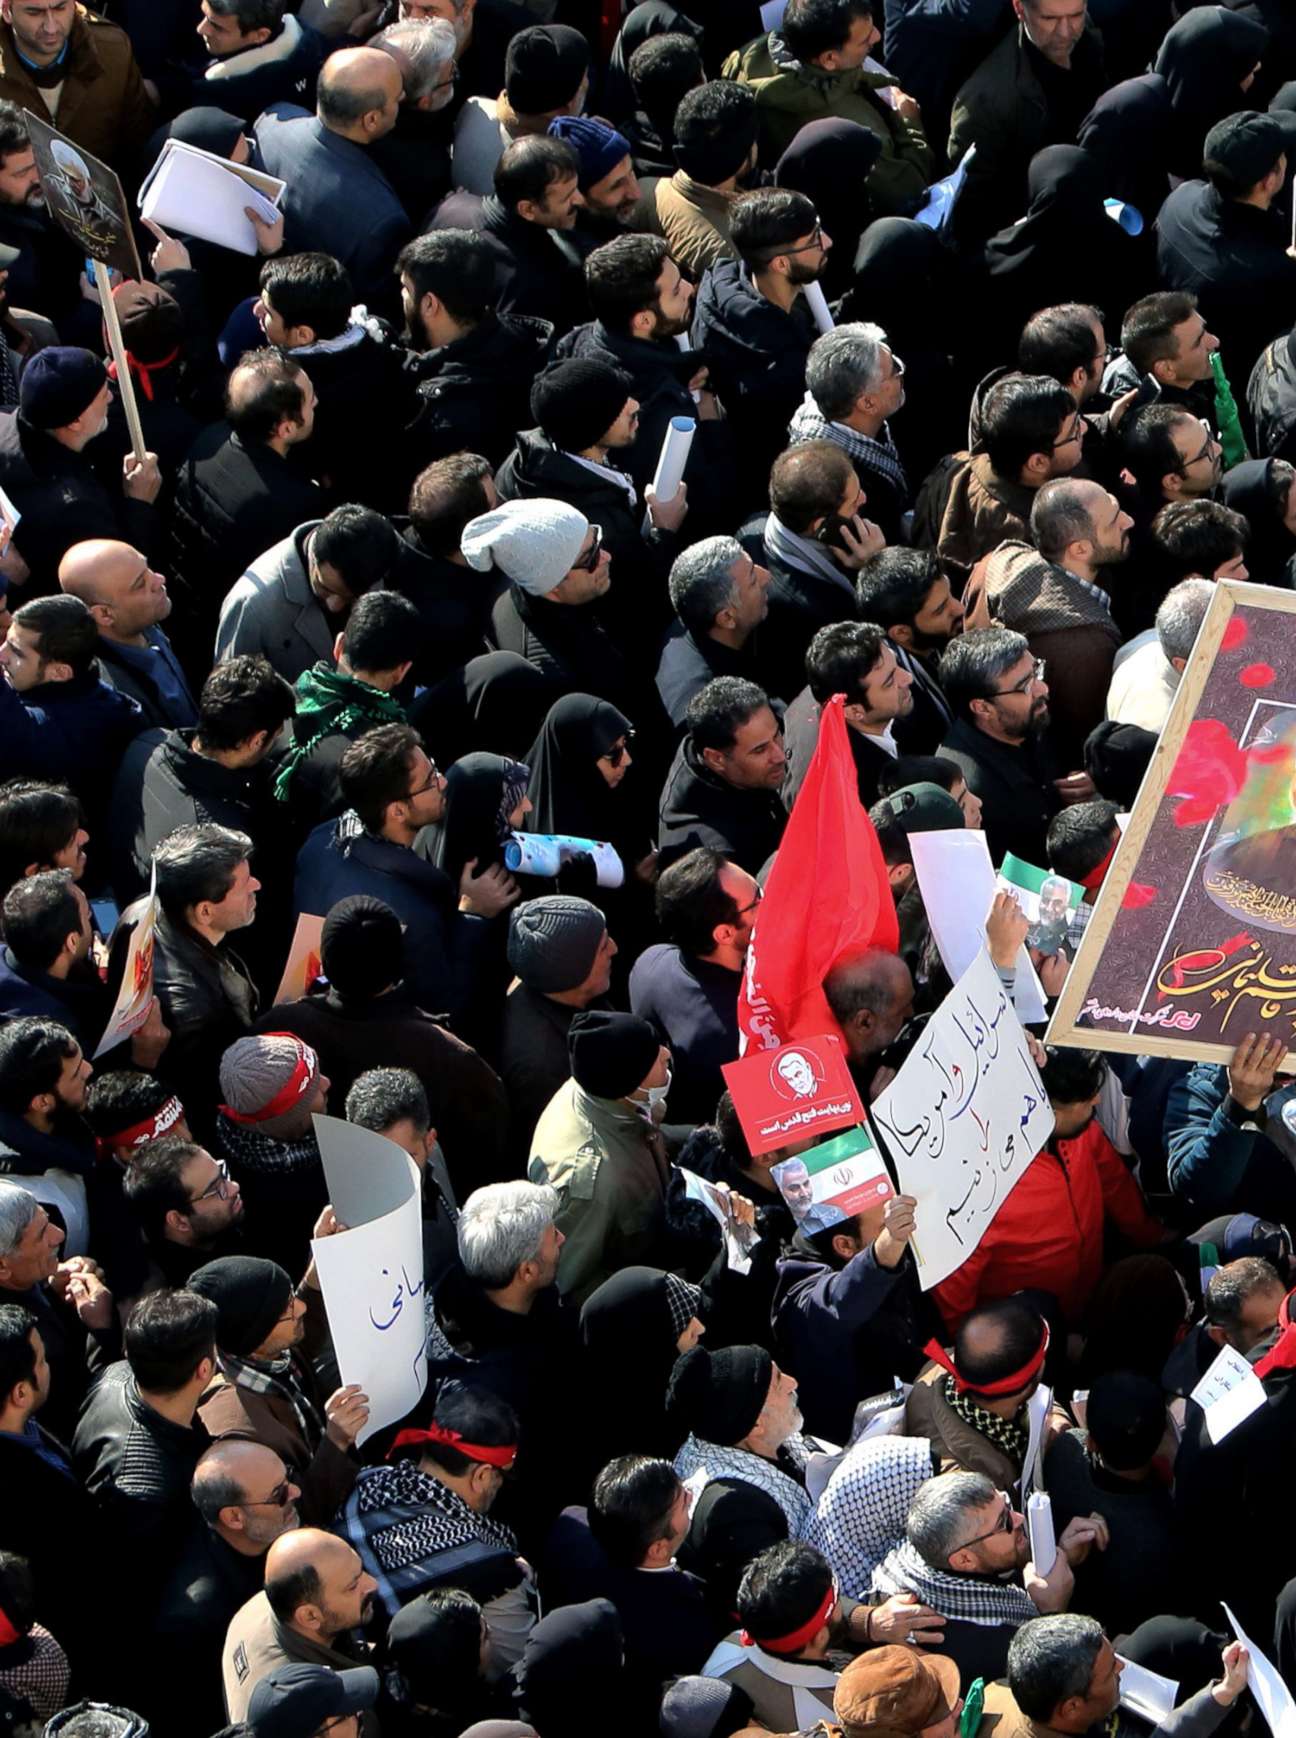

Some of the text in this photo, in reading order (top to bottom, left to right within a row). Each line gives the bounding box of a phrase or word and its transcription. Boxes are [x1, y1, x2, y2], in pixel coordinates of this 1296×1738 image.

[949, 992, 1006, 1121] سرائیل
[760, 1120, 781, 1136] است
[801, 1106, 817, 1123] فتح
[1019, 1095, 1037, 1153] هم
